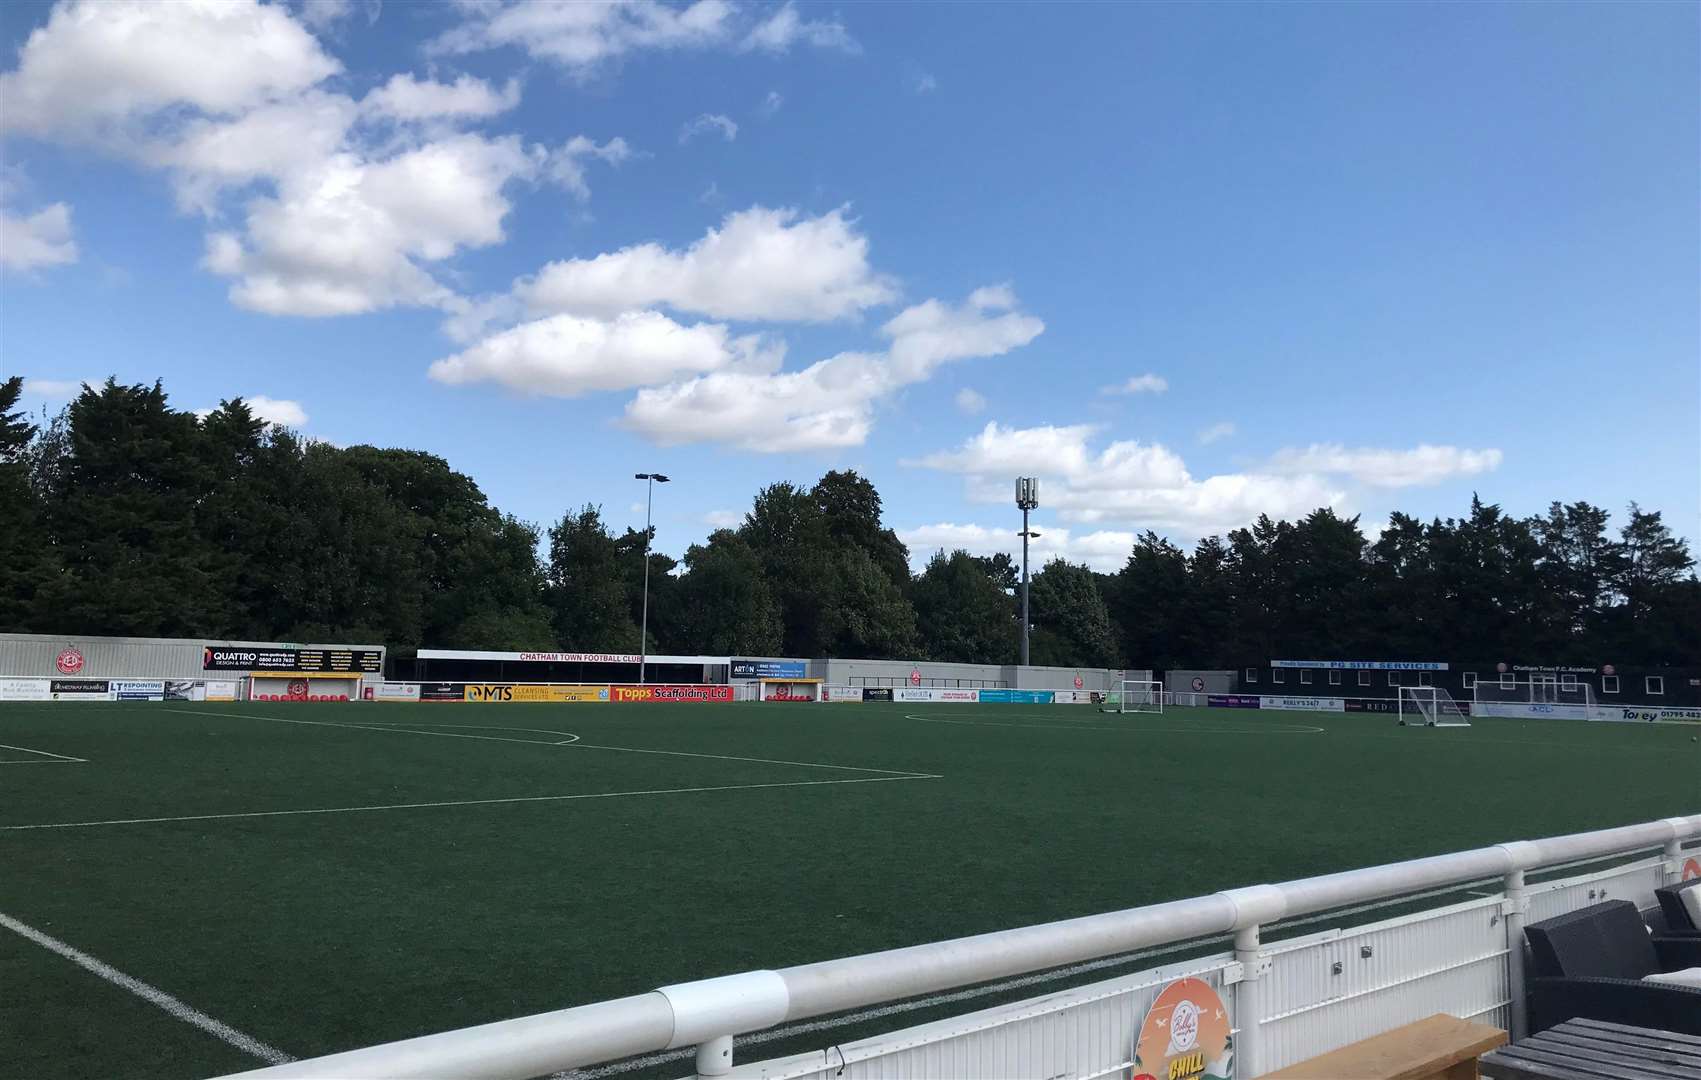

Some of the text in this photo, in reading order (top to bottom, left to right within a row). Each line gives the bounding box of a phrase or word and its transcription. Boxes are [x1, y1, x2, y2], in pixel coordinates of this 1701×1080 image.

[213, 652, 257, 661] QUATTRO
[519, 653, 642, 663] CHATHAM TOWN FOOTBALL CLUB
[1379, 662, 1440, 670] SERVICES
[1567, 666, 1597, 674] Academy
[111, 683, 123, 691] LT
[484, 686, 513, 700] MTS
[616, 688, 727, 701] Topps Scaffolding Ltd
[1168, 1051, 1205, 1080] CHILL
